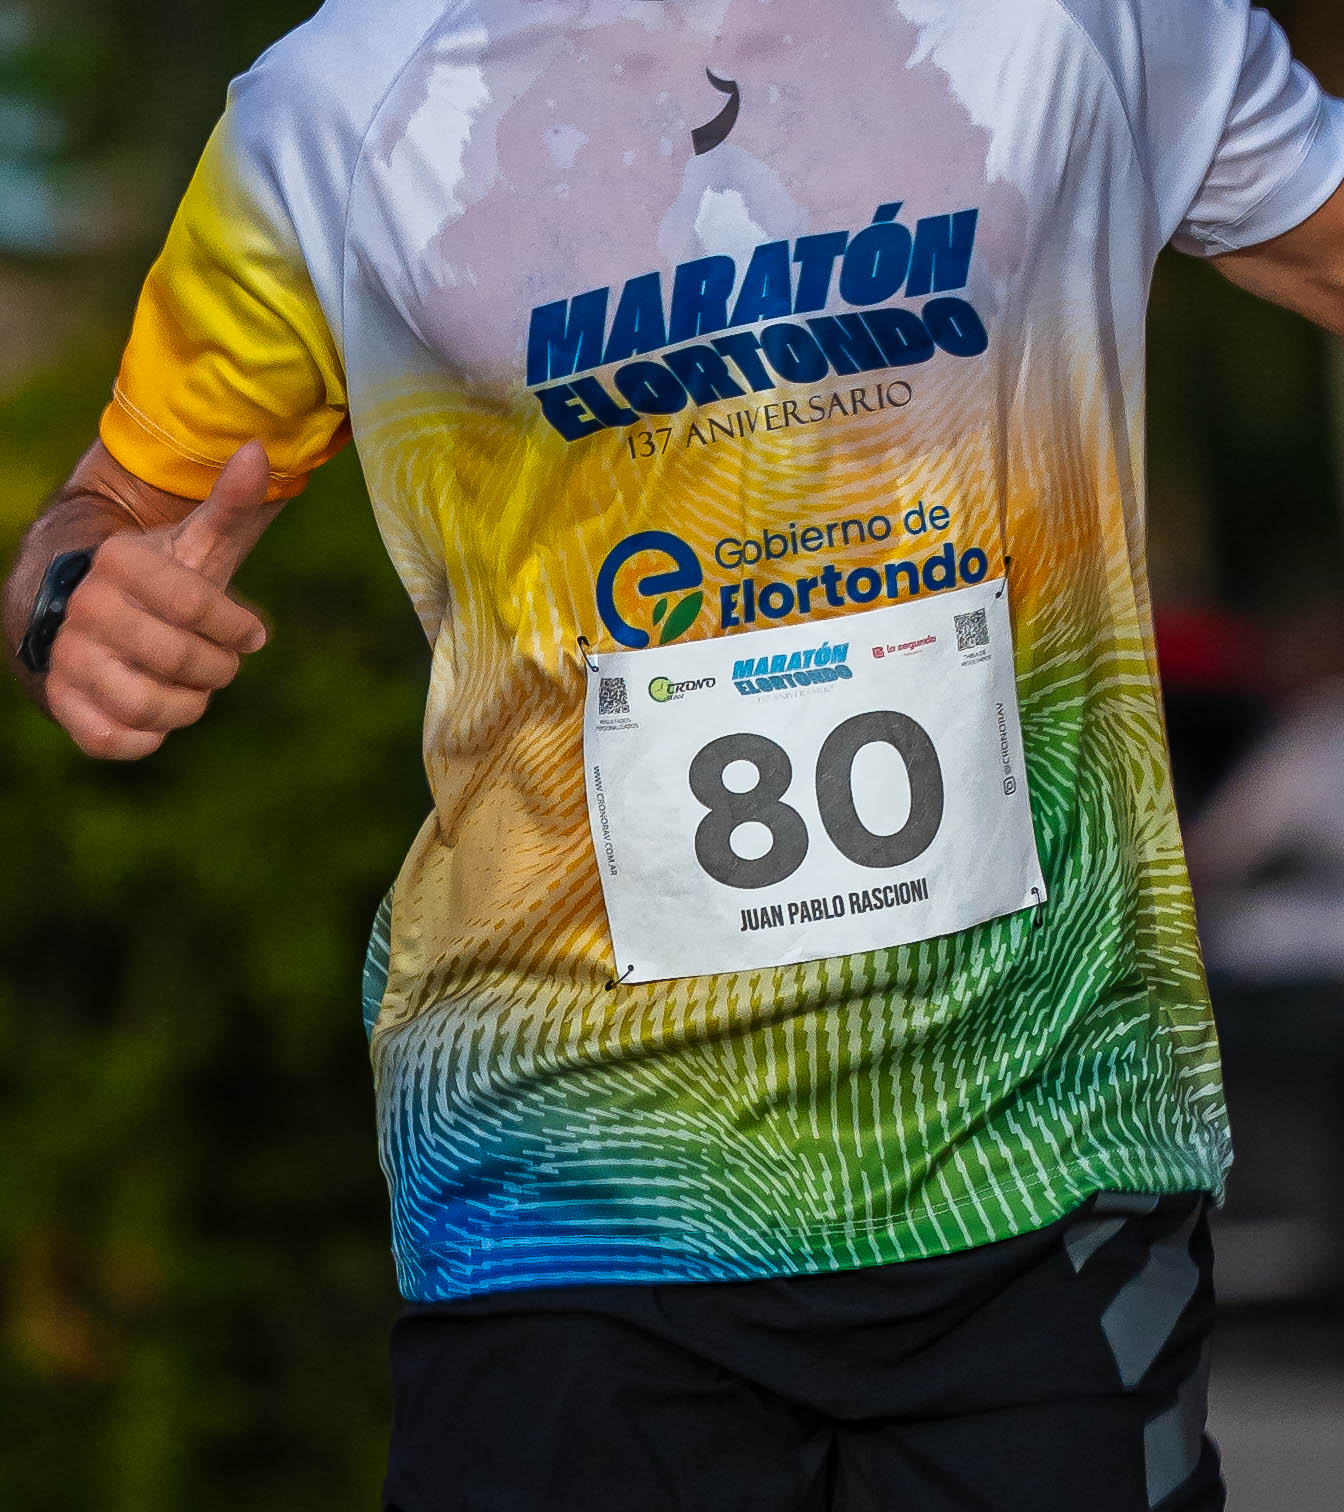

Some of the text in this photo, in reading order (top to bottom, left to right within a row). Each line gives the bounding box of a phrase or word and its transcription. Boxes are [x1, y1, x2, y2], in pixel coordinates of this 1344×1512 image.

[526, 201, 978, 387] MARATÓN
[534, 296, 989, 443] ELORTONDO
[627, 380, 914, 460] 137 ANIVERSARIO
[714, 500, 951, 570] Gobierno de
[720, 542, 989, 630] Elortondo
[732, 641, 850, 681] MARATÓN
[689, 710, 944, 890] 80
[740, 877, 929, 932] JUAN PABLO RASCIONI
